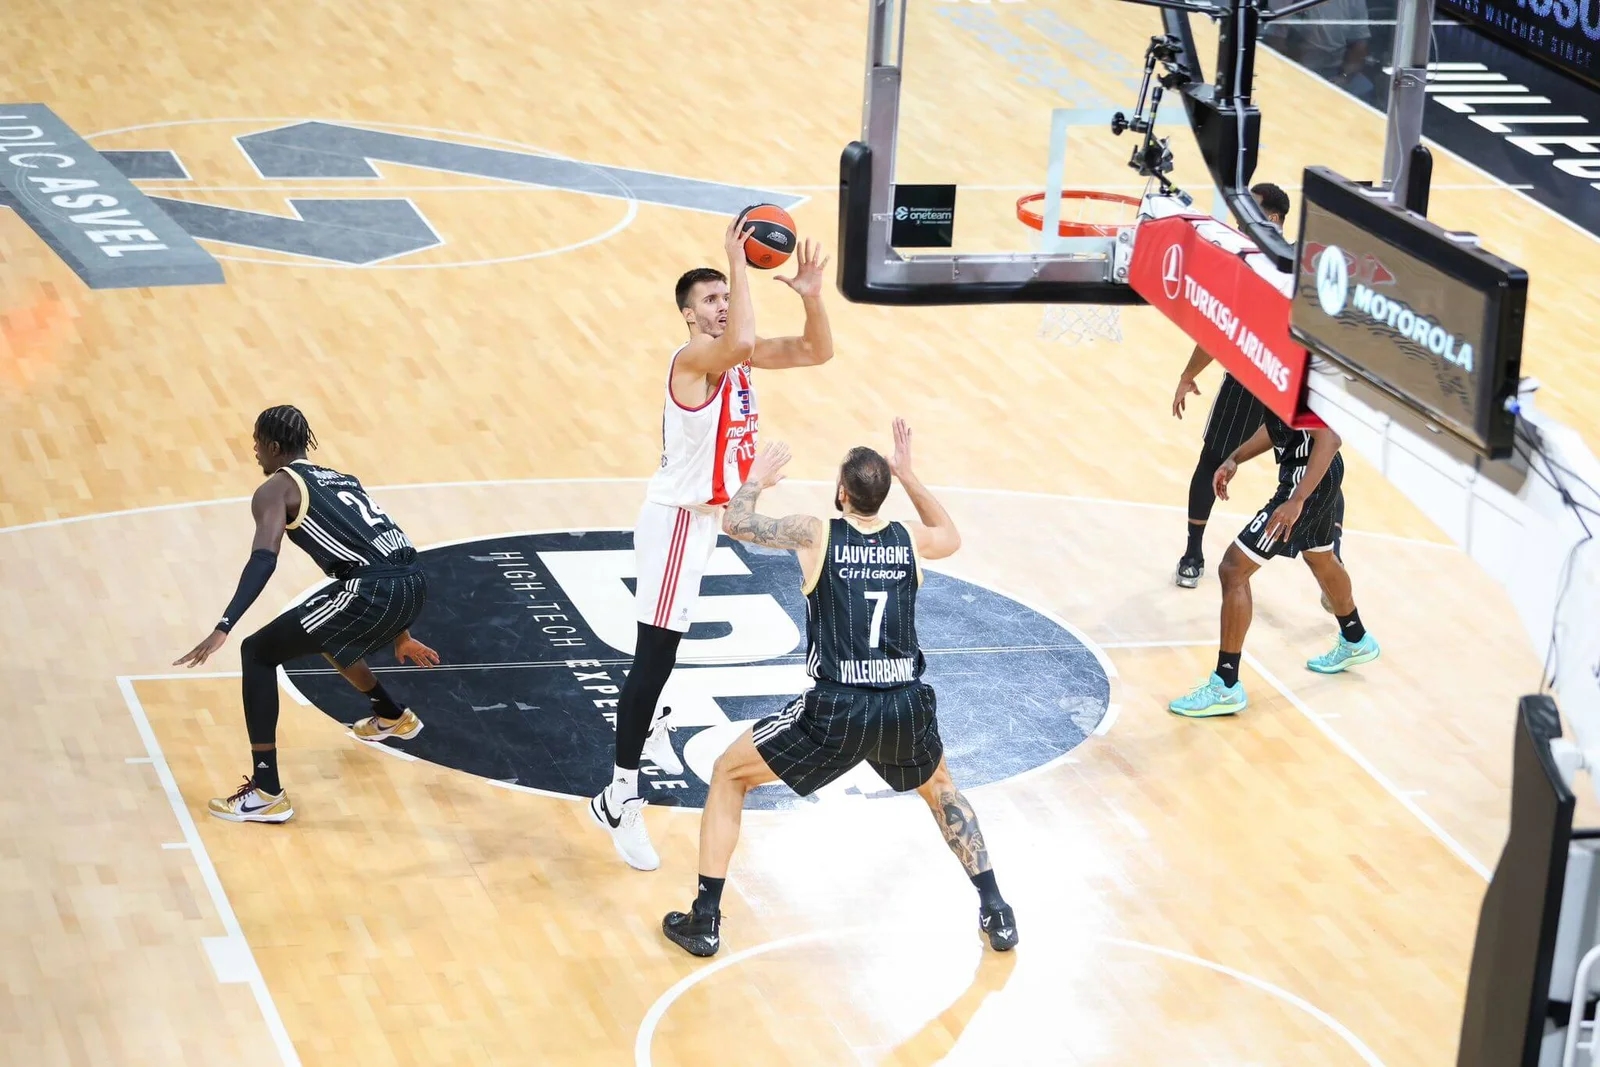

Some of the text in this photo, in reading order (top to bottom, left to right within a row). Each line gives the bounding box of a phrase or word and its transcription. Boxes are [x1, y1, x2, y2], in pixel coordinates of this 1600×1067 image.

[1485, 4, 1544, 47] WATCHES
[1551, 35, 1592, 68] SINCE
[1382, 62, 1600, 191] VILLE
[27, 176, 169, 258] ASVEL
[910, 211, 952, 220] oneteam
[1184, 274, 1291, 392] TURKISH AIRLINES
[1352, 284, 1474, 373] MOTOROLA
[834, 545, 911, 565] LAUVERGNE
[489, 551, 587, 647] HIGH-TECH
[863, 591, 889, 649] 7
[840, 657, 915, 684] VILLEURBANNE
